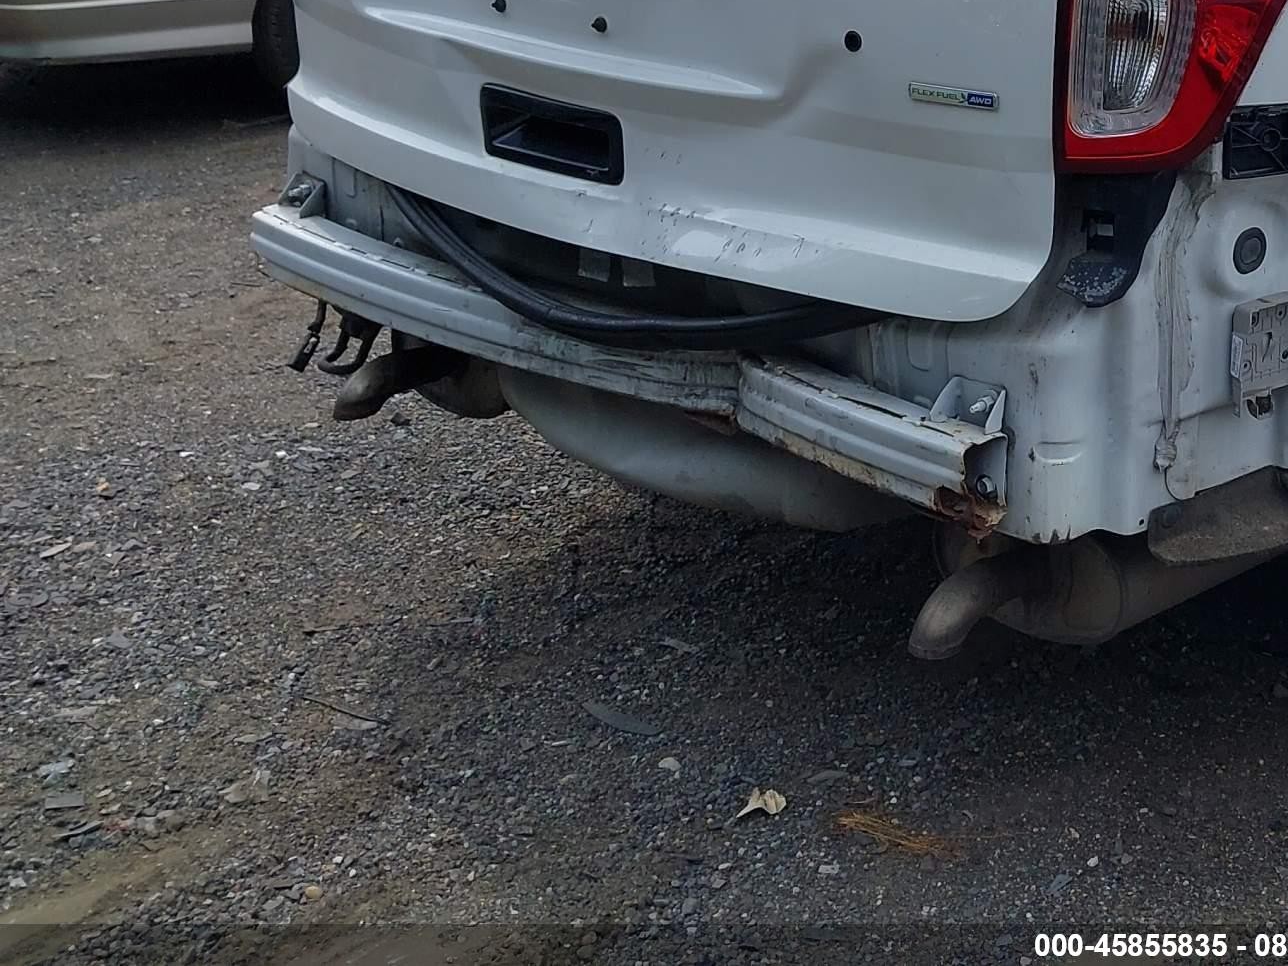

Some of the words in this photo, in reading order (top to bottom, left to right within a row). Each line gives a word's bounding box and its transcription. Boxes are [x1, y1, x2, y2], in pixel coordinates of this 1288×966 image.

[911, 87, 936, 97] FLEX
[936, 91, 961, 101] FUEL
[968, 96, 992, 105] AWD
